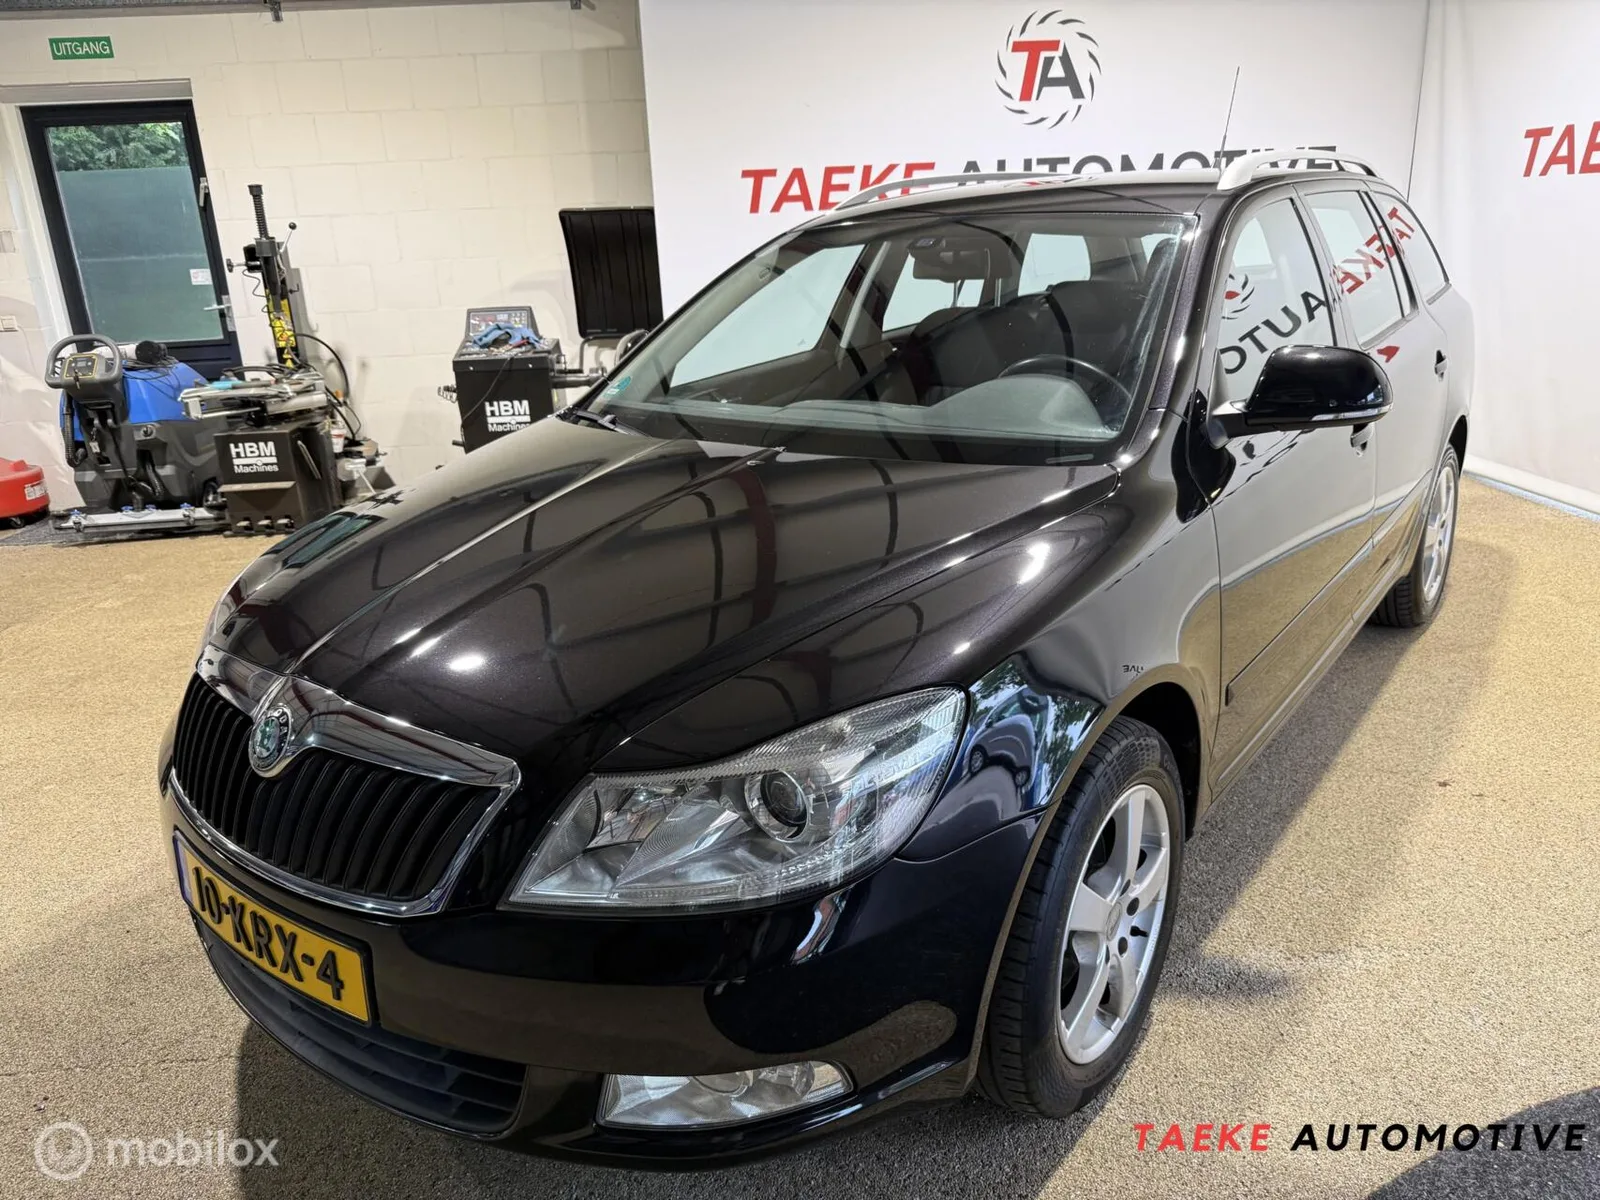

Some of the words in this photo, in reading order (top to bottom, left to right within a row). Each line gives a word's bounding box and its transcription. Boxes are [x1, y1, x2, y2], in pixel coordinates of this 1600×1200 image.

[52, 40, 111, 56] UITGANG
[1011, 39, 1086, 102] TA
[485, 399, 530, 417] HBM
[229, 440, 276, 458] HBM
[233, 464, 279, 474] Machines
[192, 866, 345, 1001] 10-KRX-4
